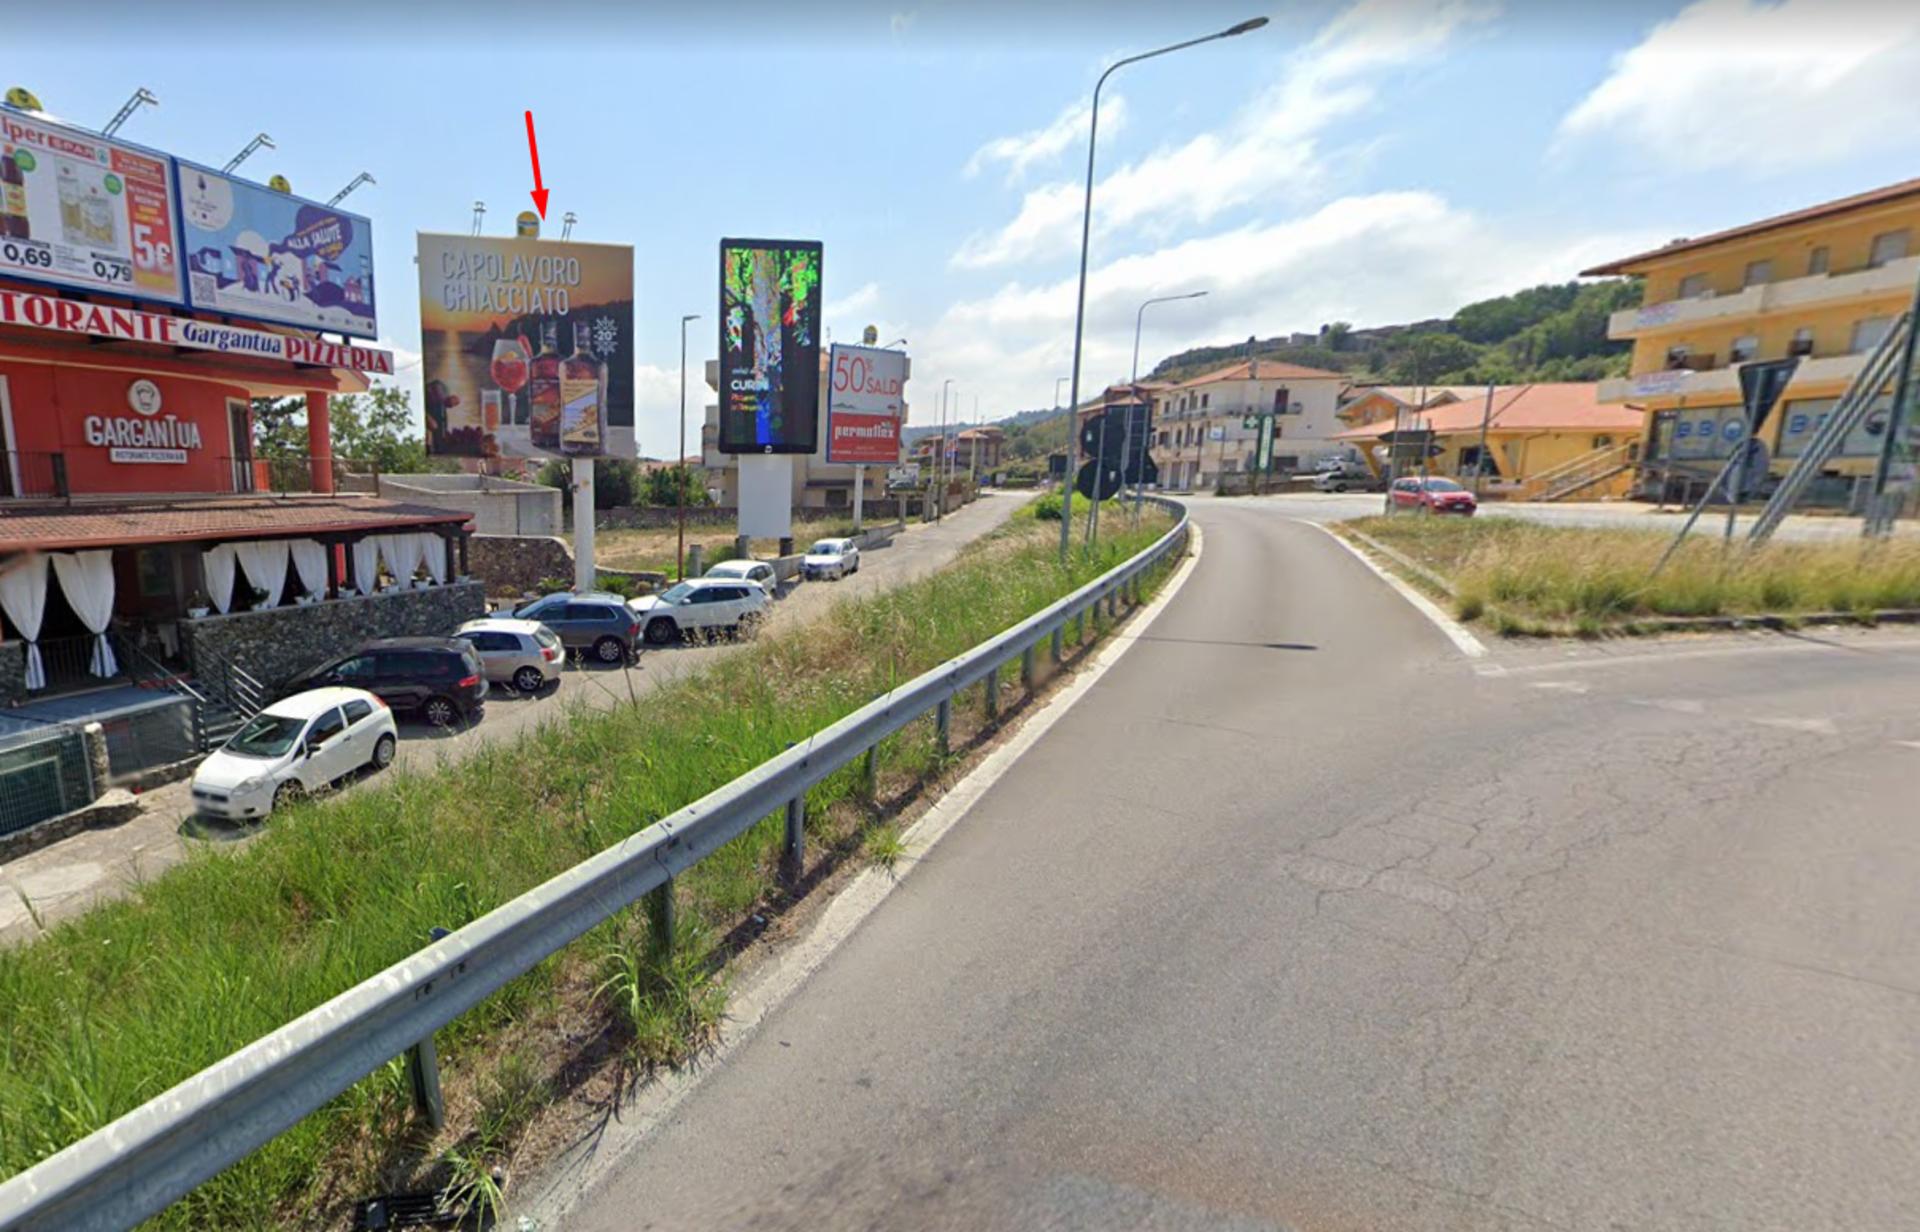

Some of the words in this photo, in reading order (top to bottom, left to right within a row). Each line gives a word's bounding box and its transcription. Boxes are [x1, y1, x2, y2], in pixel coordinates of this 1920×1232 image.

[4, 243, 52, 268] 0,69
[93, 261, 132, 283] 0,79
[442, 251, 580, 287] CAPOLAVORO
[183, 322, 281, 353] Gargantua
[284, 336, 389, 373] PIZZERIA
[835, 423, 894, 440] permaflex
